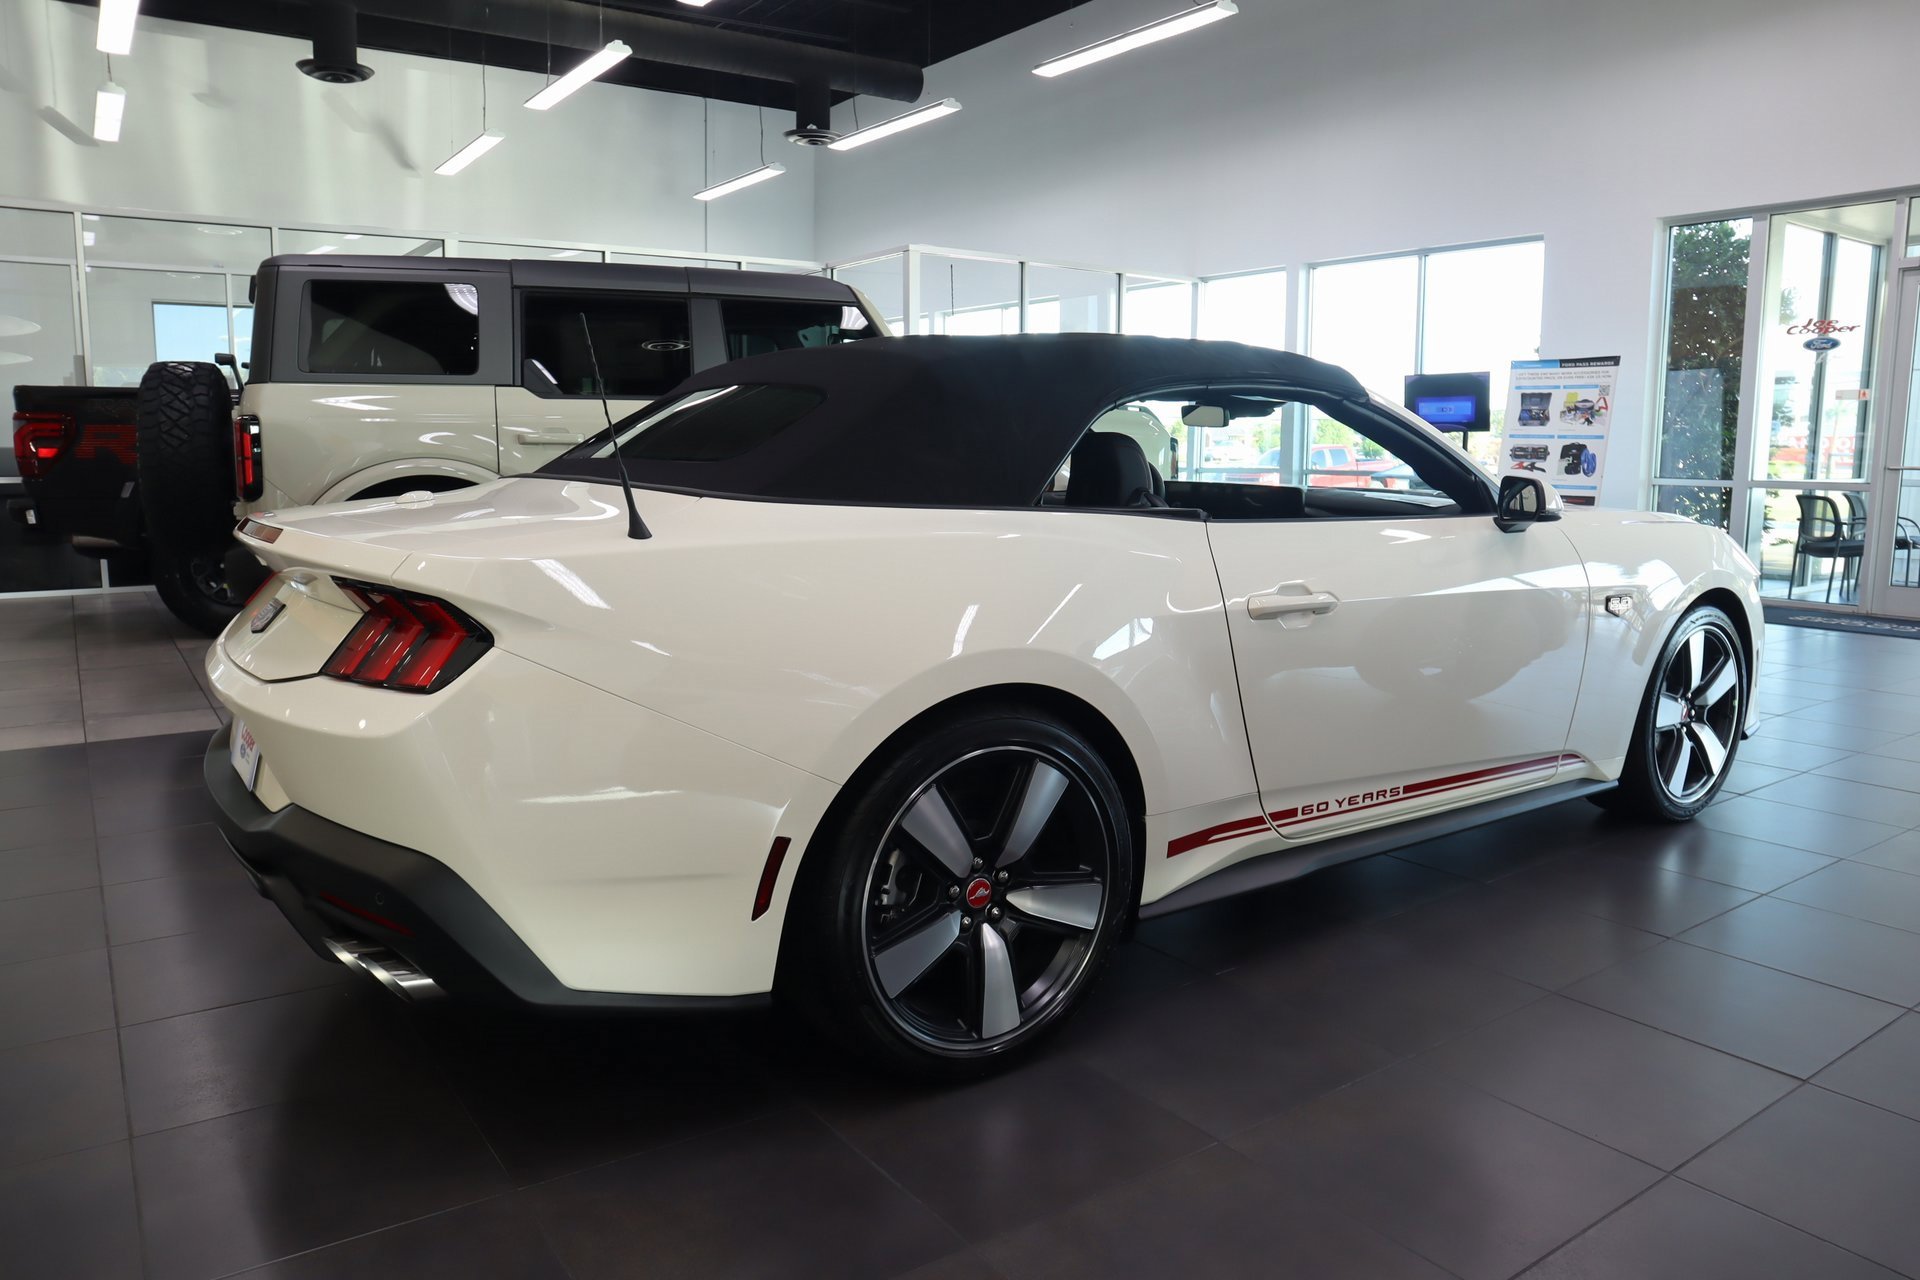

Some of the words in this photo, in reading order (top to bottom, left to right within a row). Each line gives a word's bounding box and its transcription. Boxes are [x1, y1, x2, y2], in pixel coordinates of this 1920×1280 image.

[1802, 318, 1839, 329] Joe
[1786, 324, 1861, 335] Cooper
[1810, 339, 1833, 349] Ford
[1301, 801, 1329, 816] 60
[1334, 786, 1401, 808] YEARS
